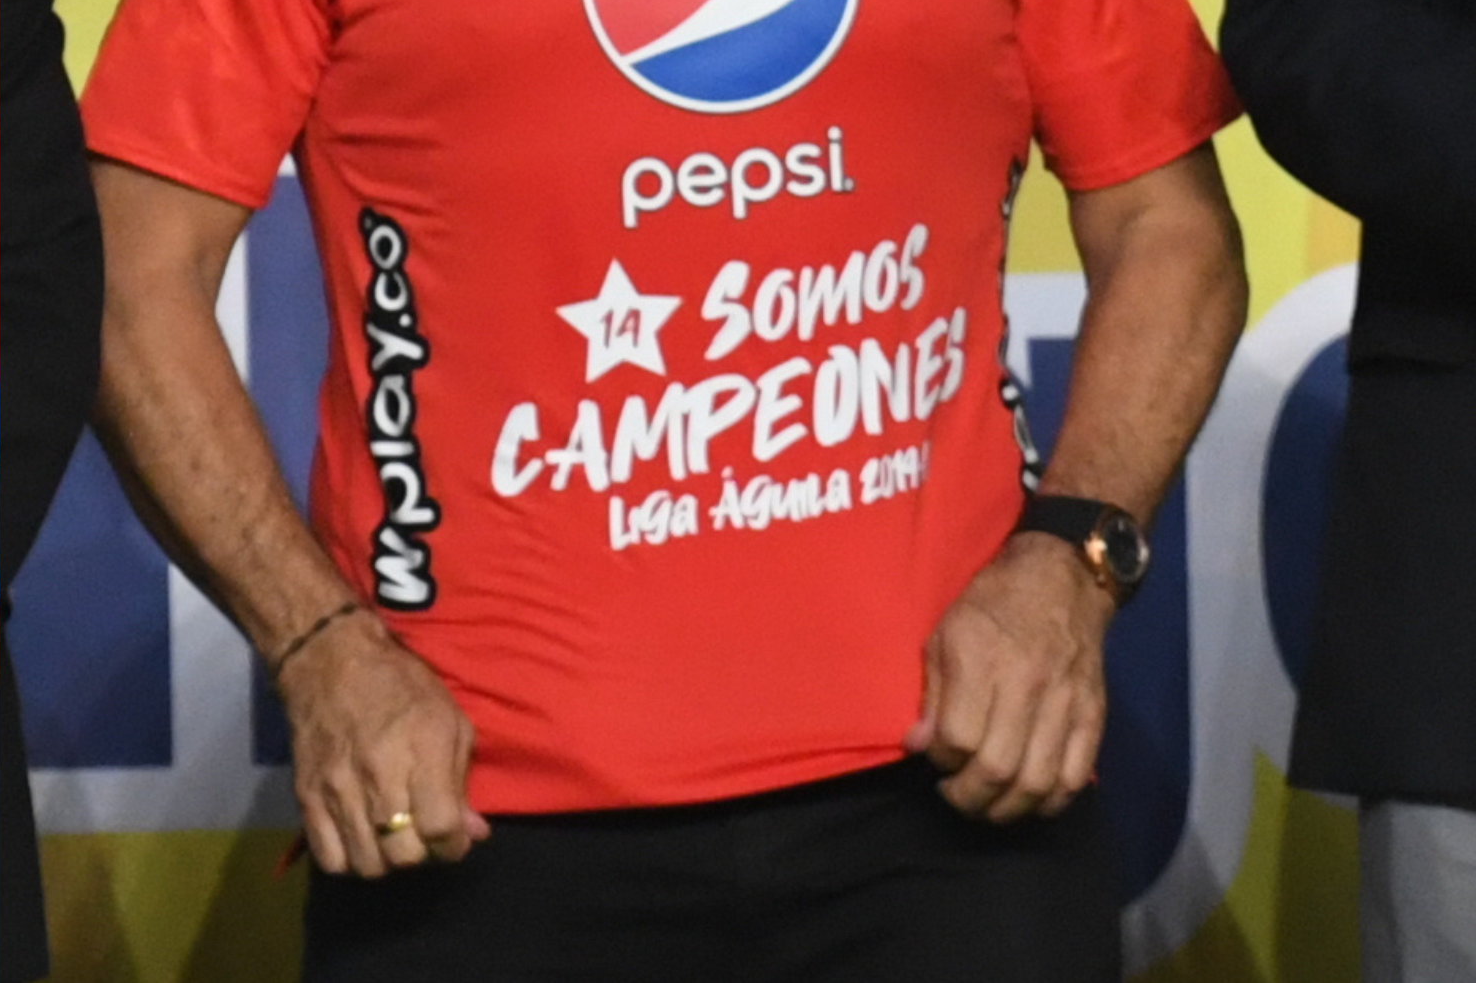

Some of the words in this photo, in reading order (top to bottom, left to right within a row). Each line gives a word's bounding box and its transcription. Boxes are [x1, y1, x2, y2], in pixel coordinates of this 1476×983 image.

[600, 307, 641, 349] 14
[702, 224, 928, 361] SOMOS
[367, 223, 435, 604] wplay.co
[491, 307, 966, 498] CAMPEONES
